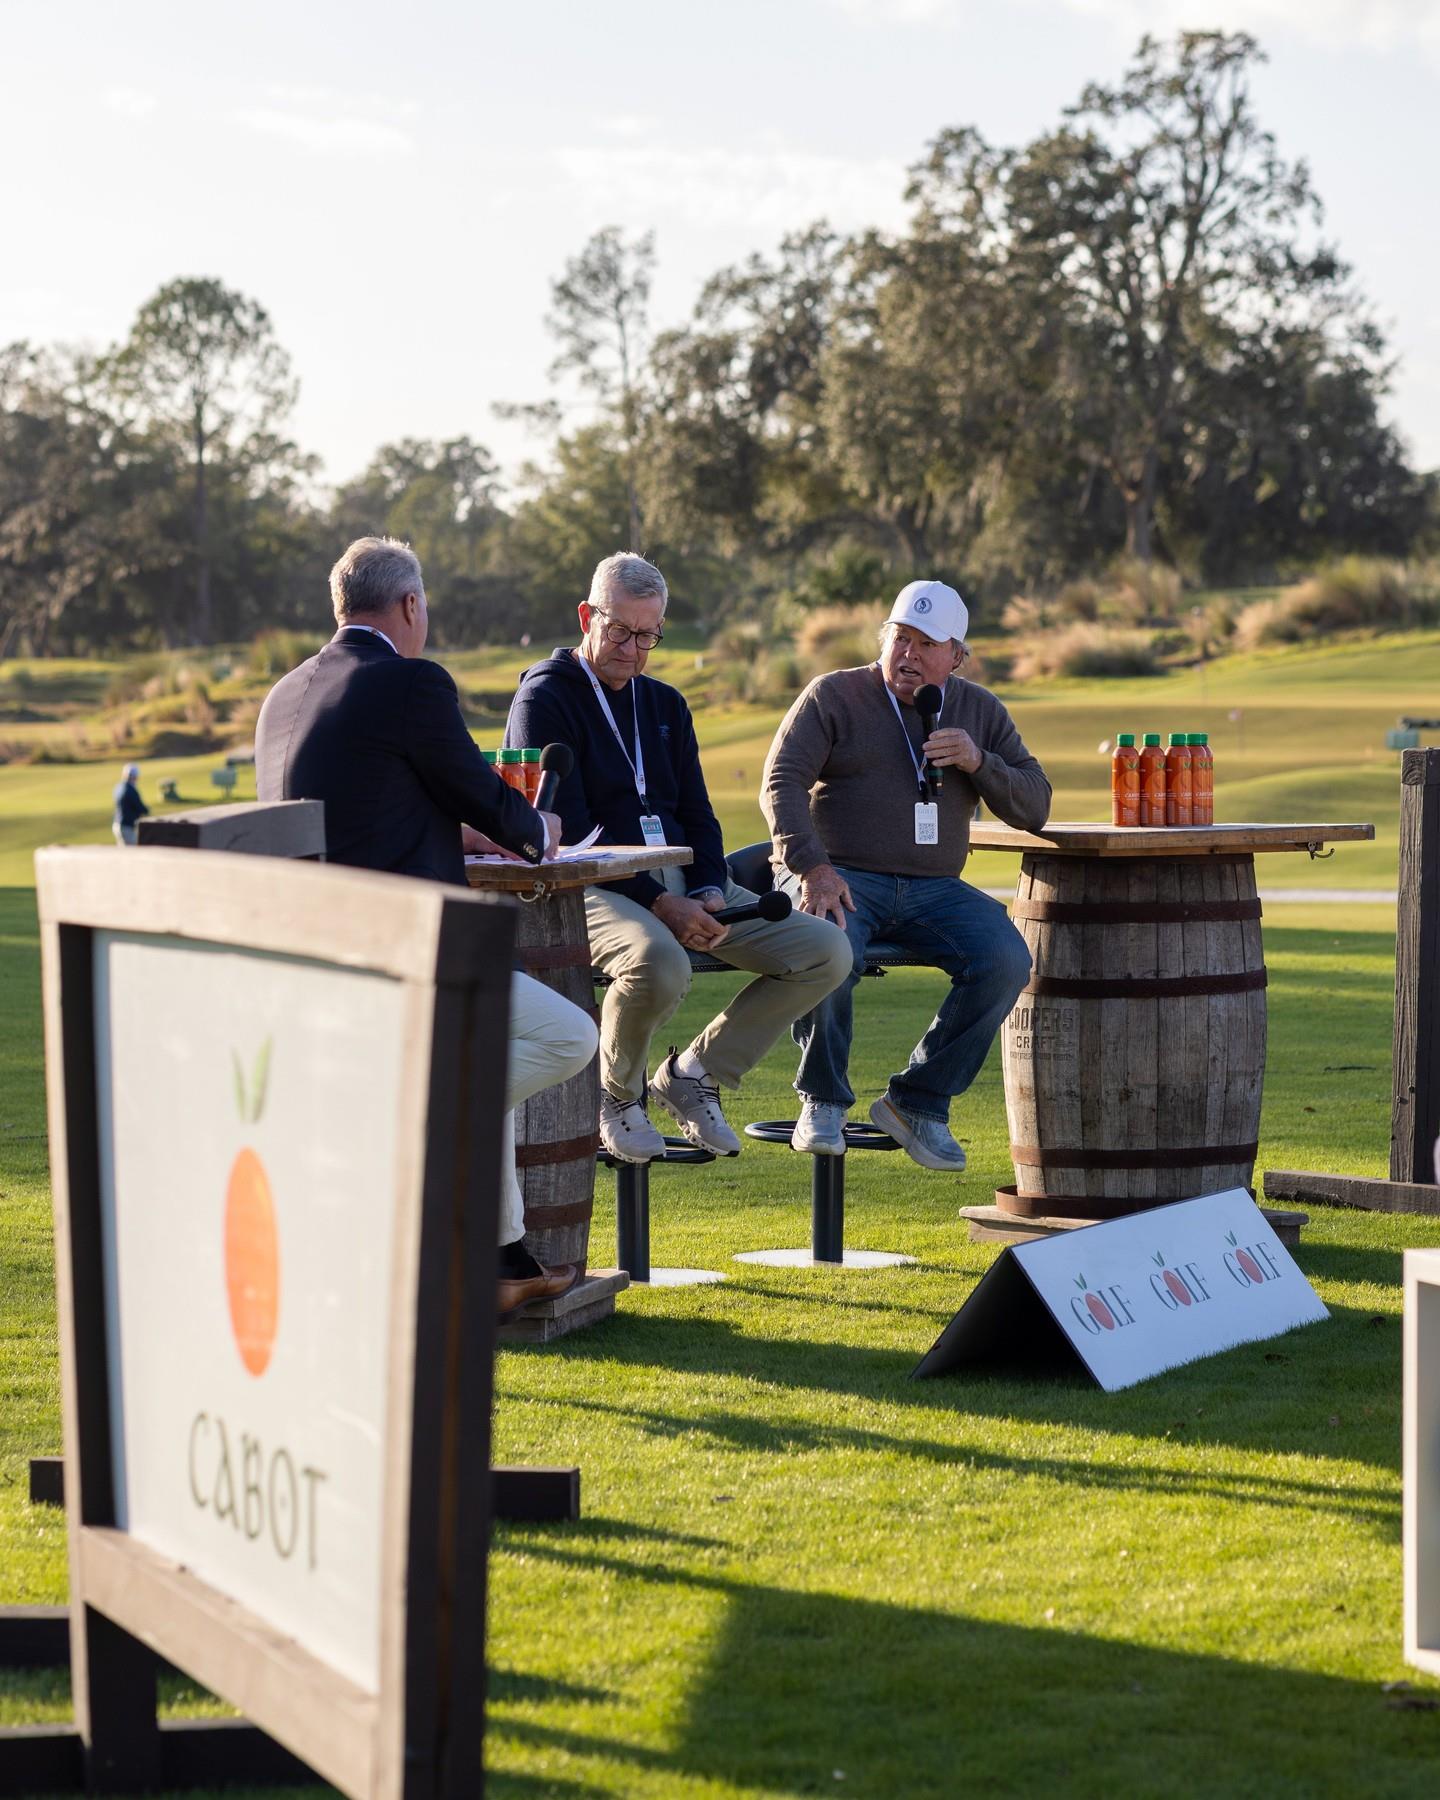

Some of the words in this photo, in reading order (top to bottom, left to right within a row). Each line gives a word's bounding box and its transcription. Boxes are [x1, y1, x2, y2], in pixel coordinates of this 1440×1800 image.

[1070, 1285, 1137, 1336] GOLF
[1149, 1262, 1212, 1312] GOLF
[1223, 1241, 1282, 1289] GOLF
[187, 1411, 329, 1572] CABOT
